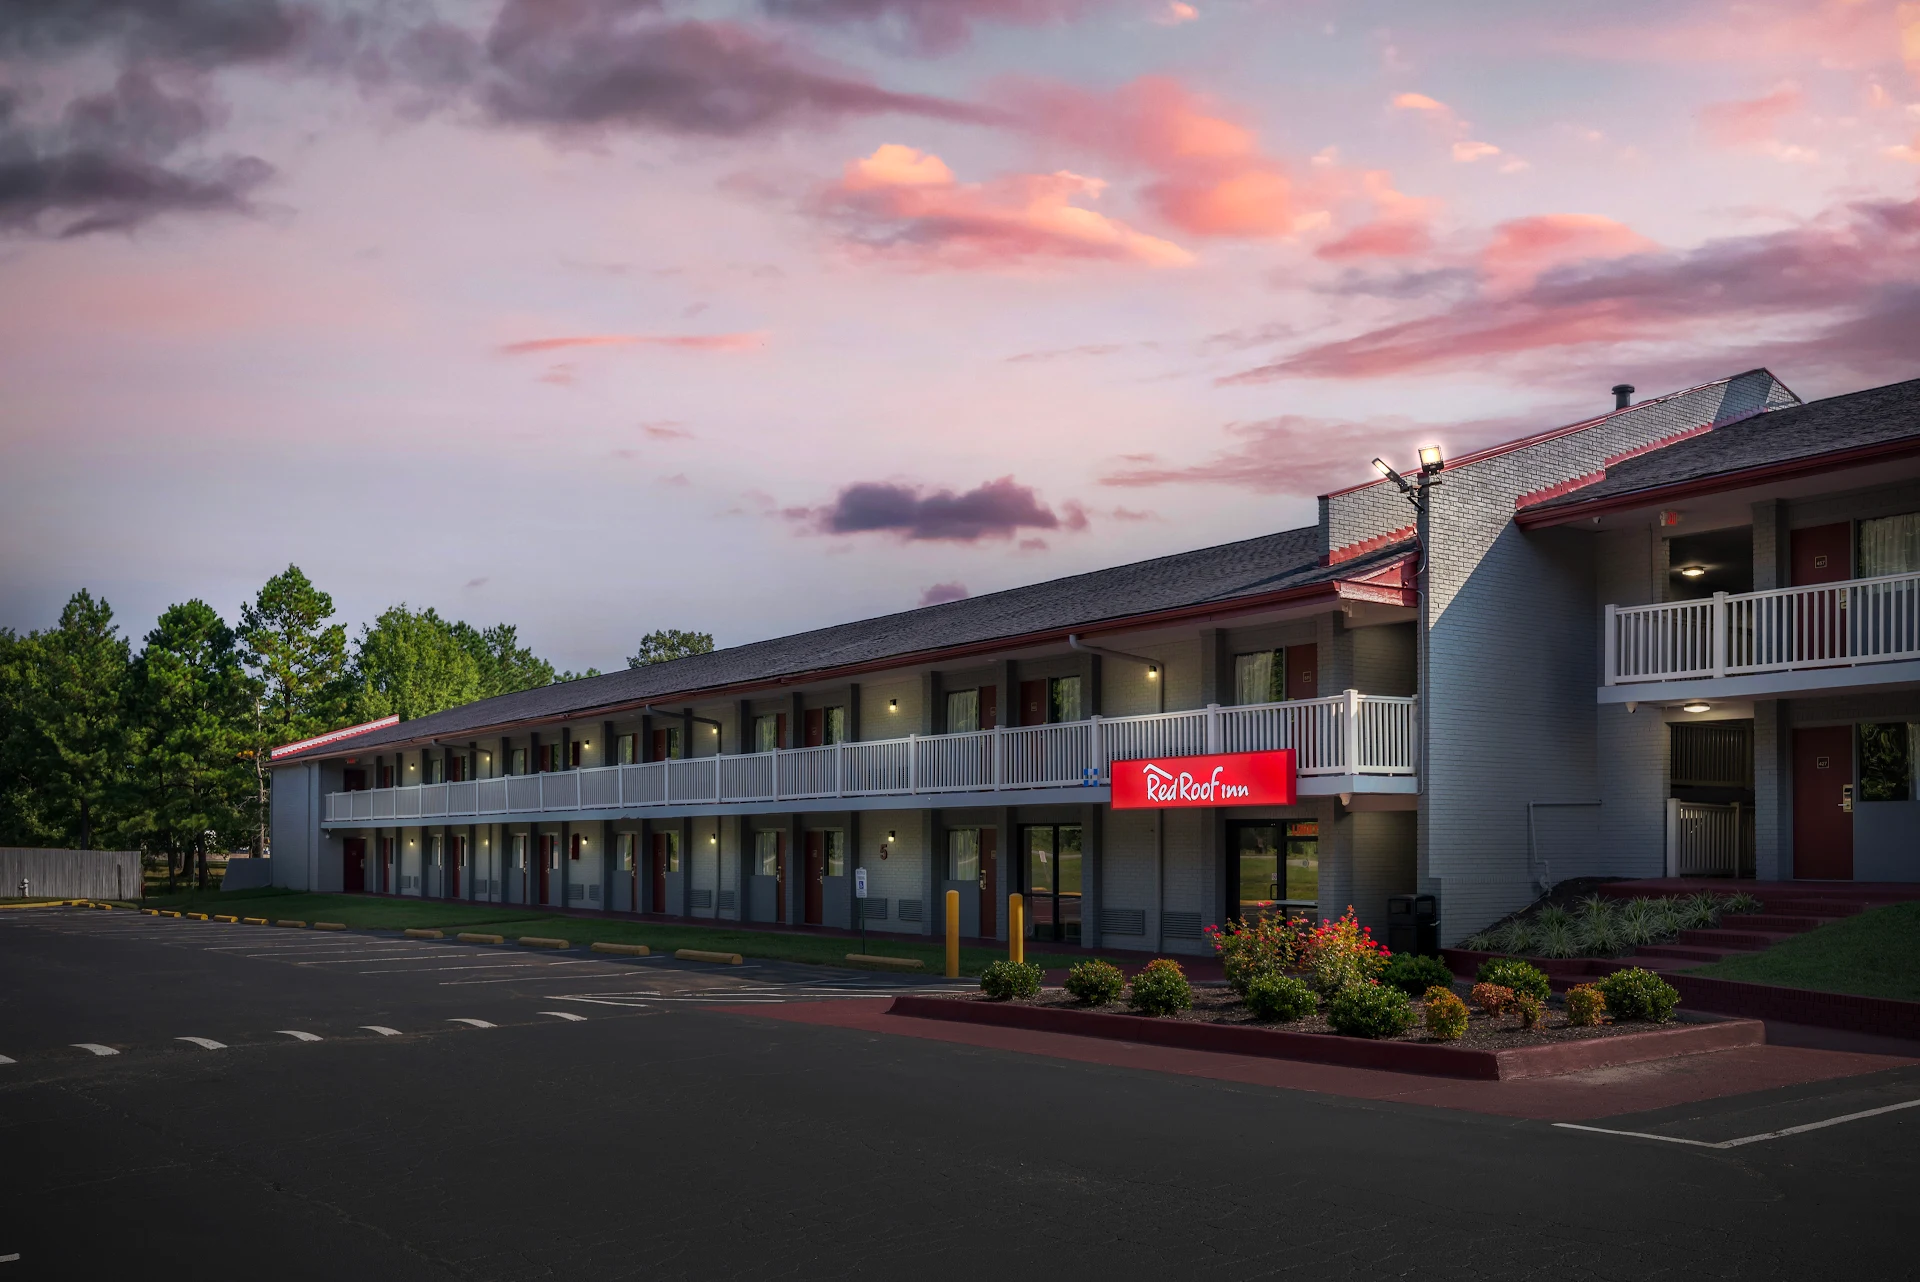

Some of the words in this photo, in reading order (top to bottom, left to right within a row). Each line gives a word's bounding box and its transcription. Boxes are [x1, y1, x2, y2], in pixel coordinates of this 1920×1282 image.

[1147, 773, 1178, 802] Red
[1179, 766, 1224, 802] Roof
[880, 843, 888, 861] 5
